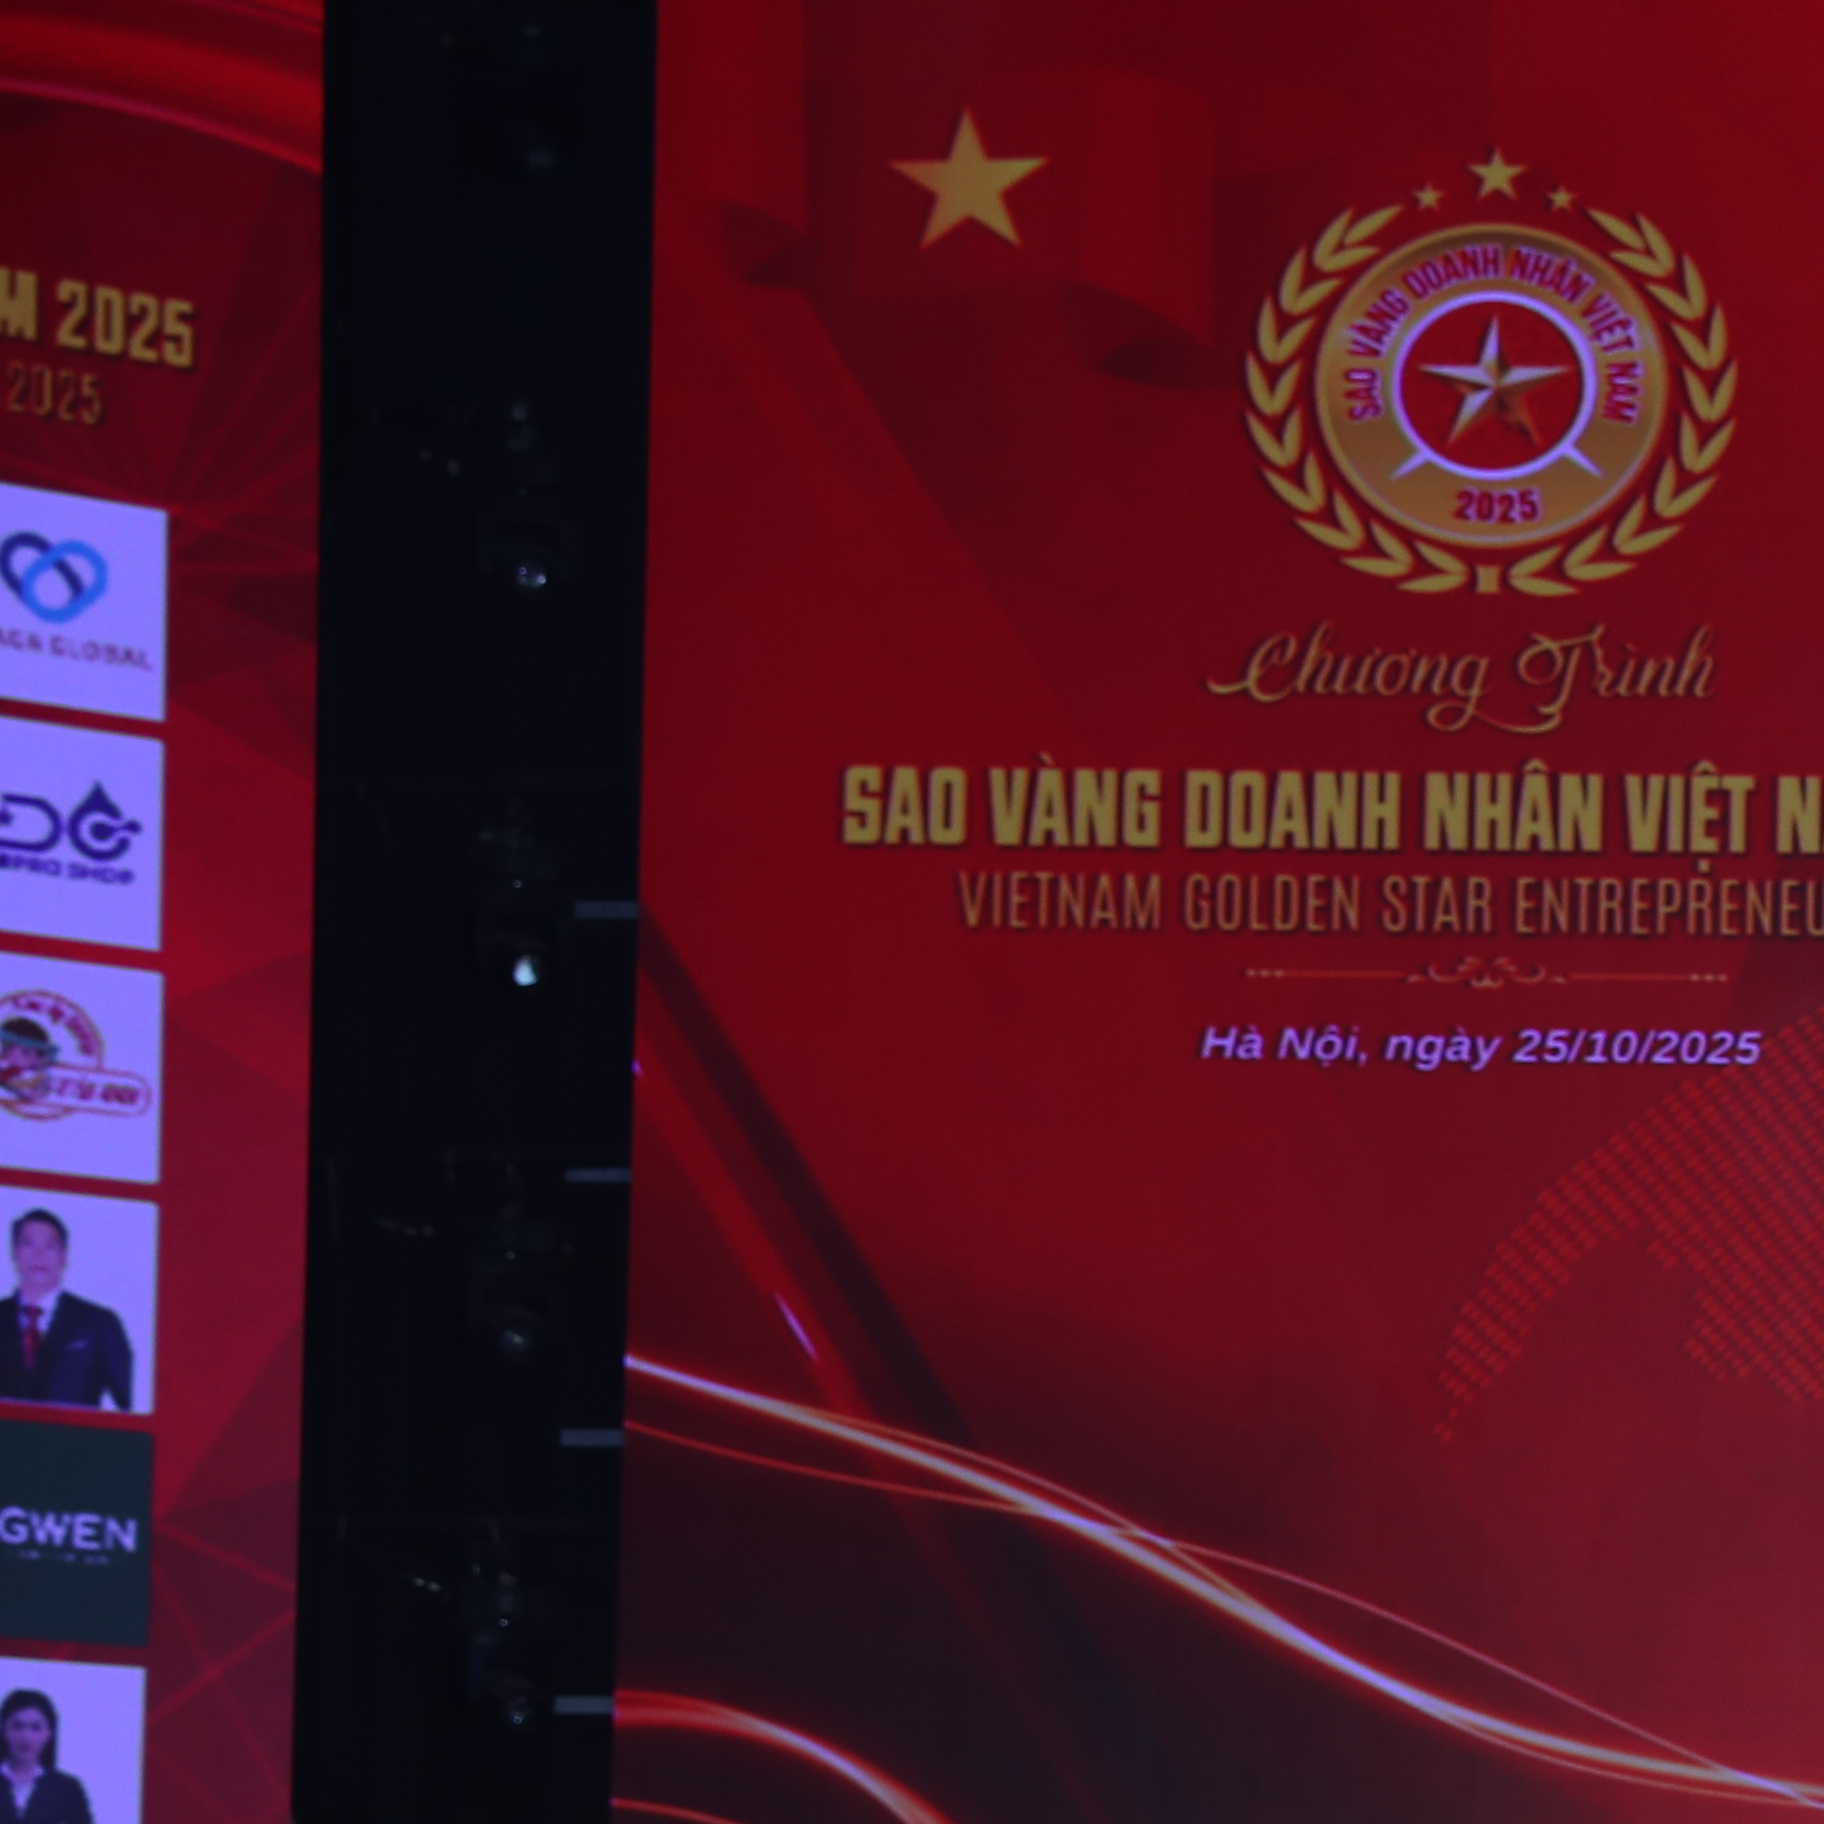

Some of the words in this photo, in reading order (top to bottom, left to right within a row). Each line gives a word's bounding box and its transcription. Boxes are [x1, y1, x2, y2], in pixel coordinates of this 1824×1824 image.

[56, 278, 194, 369] 2025
[1344, 367, 1384, 422] SAO
[1403, 243, 1502, 300] DOANH
[1601, 359, 1645, 426] NAM
[8, 358, 104, 425] 2025
[1454, 486, 1542, 523] 2025
[1206, 621, 1562, 733] Chương
[1516, 625, 1715, 717] Trình
[843, 765, 968, 845] SAO
[988, 753, 1161, 848] VÀNG
[1183, 770, 1401, 849] DOANH
[1424, 760, 1602, 851] NHÂN
[1624, 760, 1755, 873] VIỆT
[958, 870, 1162, 930] VIETNAM
[1182, 873, 1360, 933] GOLDEN
[1381, 875, 1491, 934] STAR
[1201, 1026, 1264, 1061] Hà
[1277, 1024, 1368, 1069] Nội,
[1385, 1028, 1503, 1073] ngày
[1513, 1028, 1762, 1066] 25/10/2025
[0, 1505, 138, 1552] GWEN
